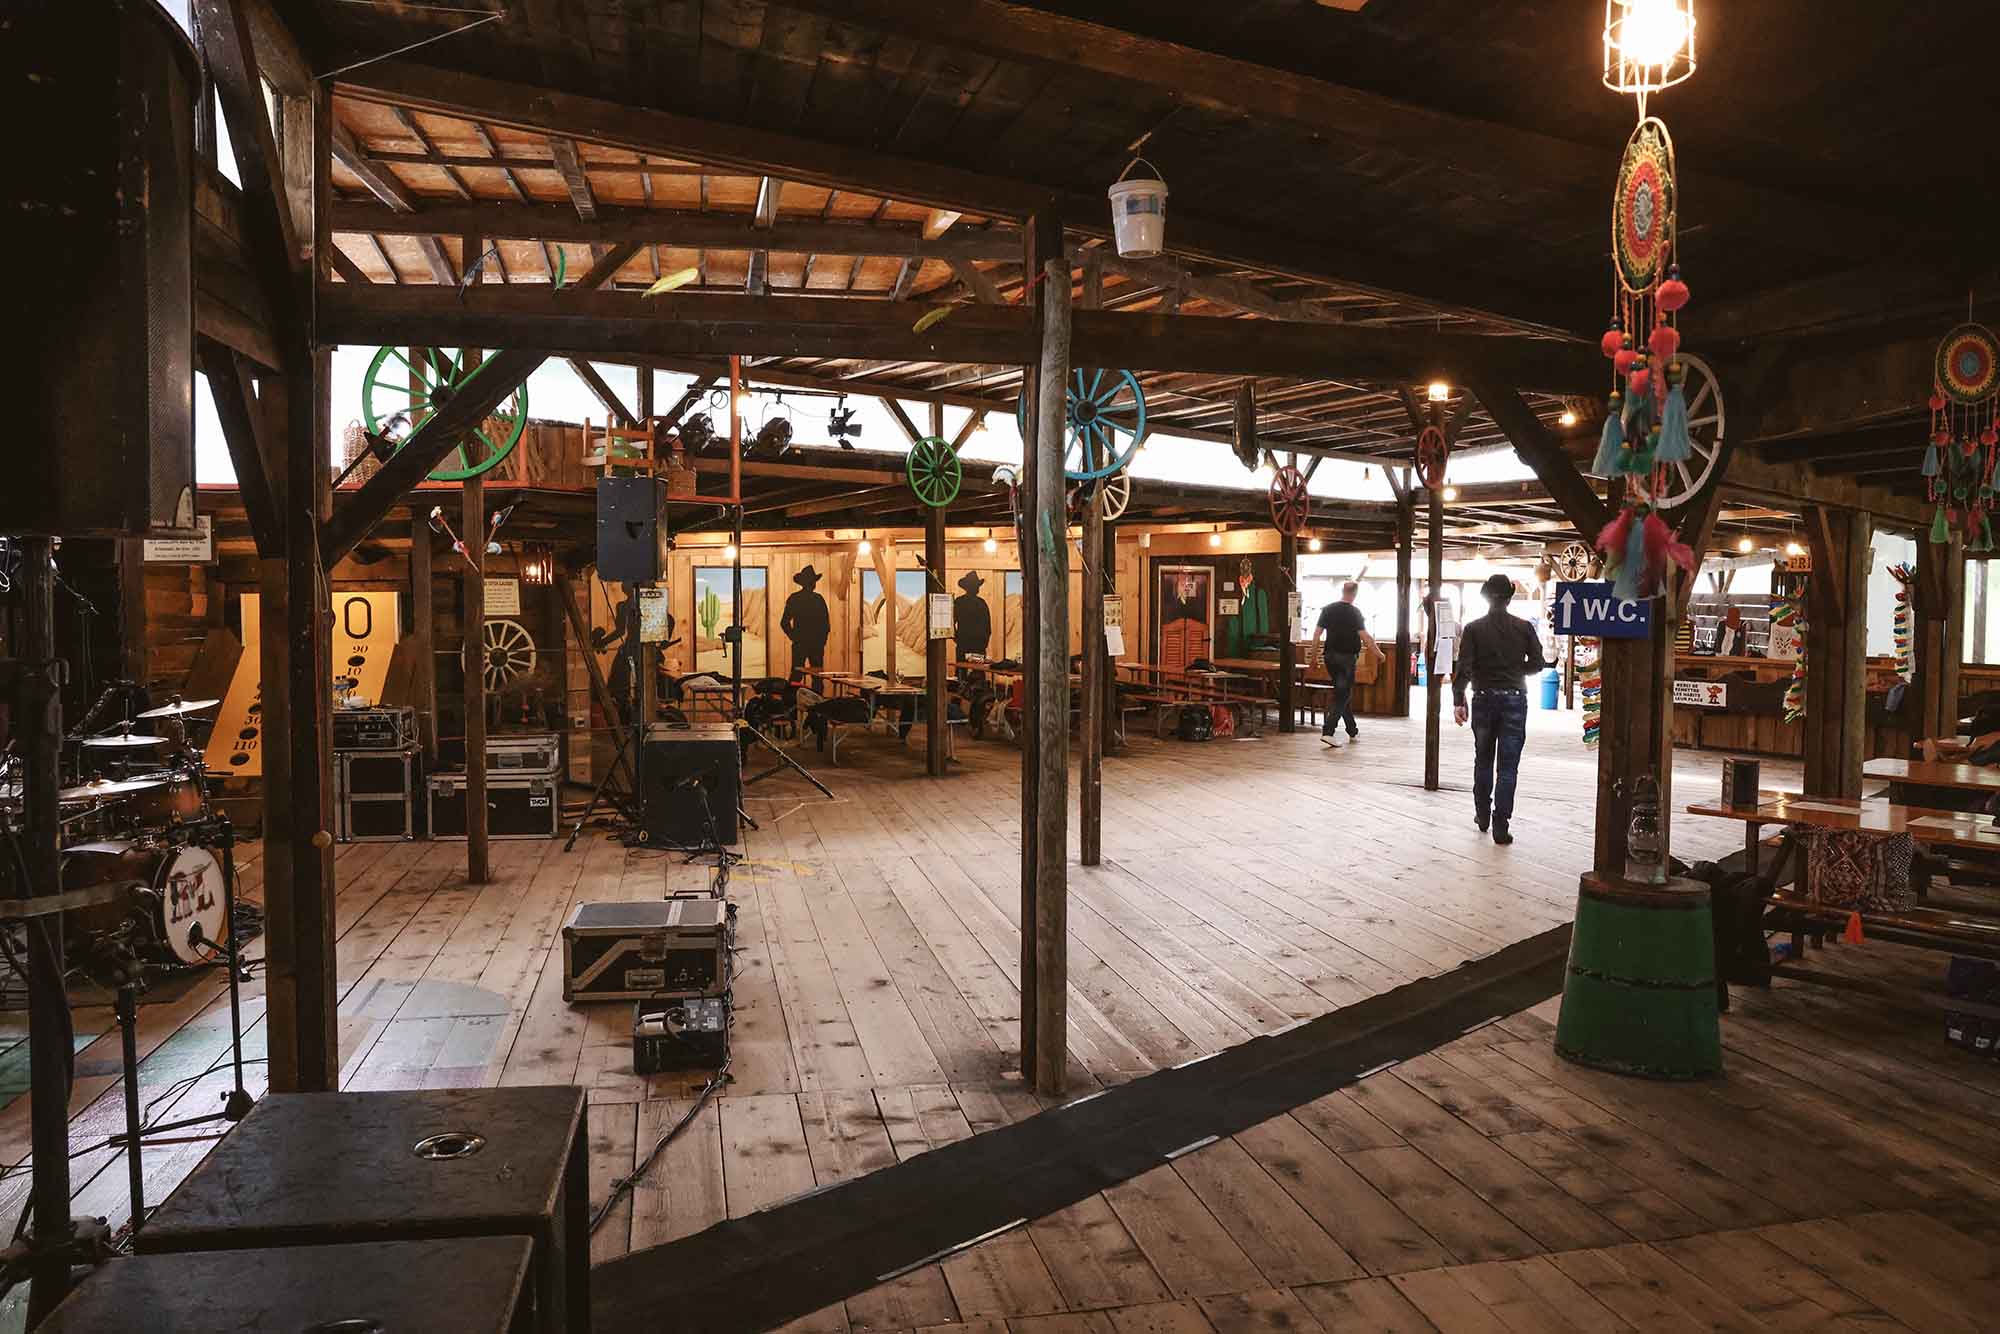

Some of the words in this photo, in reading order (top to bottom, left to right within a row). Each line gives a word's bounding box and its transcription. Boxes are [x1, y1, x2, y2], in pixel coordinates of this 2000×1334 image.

[1583, 598, 1646, 622] W.C.
[352, 645, 368, 654] 90
[233, 741, 257, 750] 110
